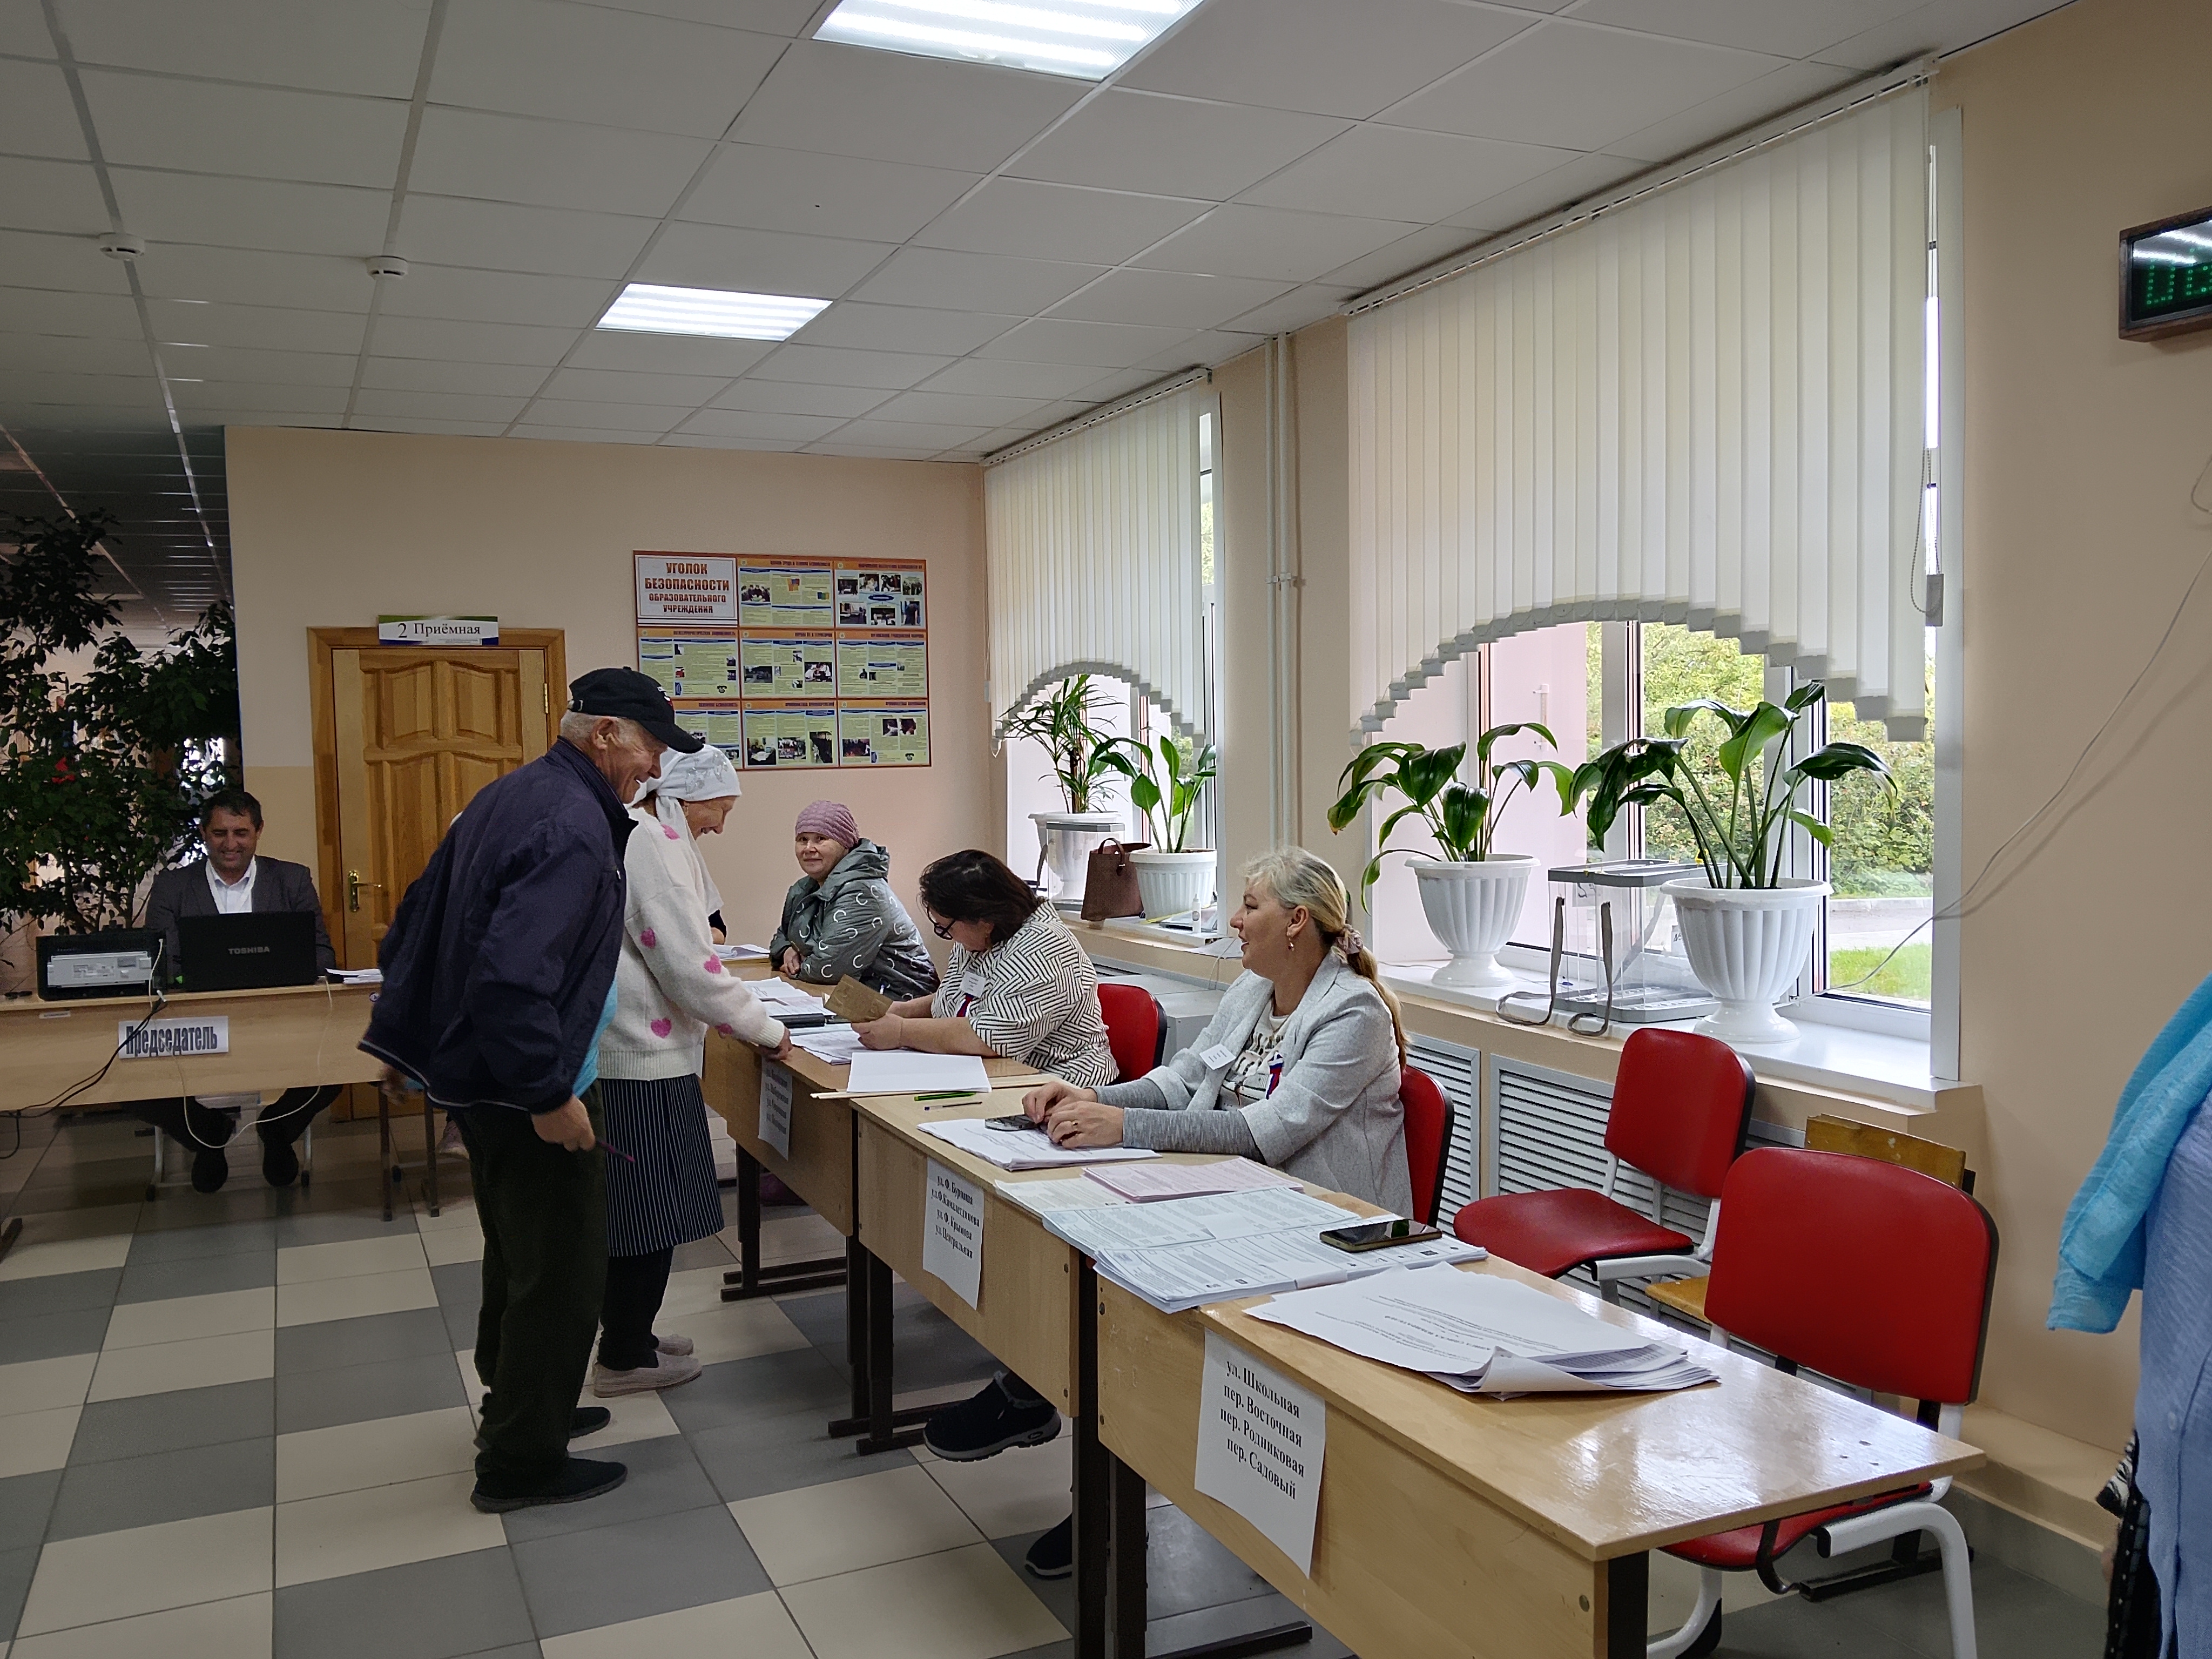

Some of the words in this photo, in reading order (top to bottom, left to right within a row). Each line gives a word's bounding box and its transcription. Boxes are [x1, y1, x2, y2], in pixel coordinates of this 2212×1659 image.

[665, 562, 707, 575] УГОЛОК
[644, 578, 730, 591] БЕЗОПАСНОСТИ
[649, 593, 726, 603] ОБРАЗОВАТЕЛЬНОГО
[663, 604, 713, 614] УЧРЕЖДЕНИЯ
[397, 623, 407, 638] 2
[414, 623, 481, 637] Приёмная
[228, 946, 270, 955] TOSHIBA
[126, 1026, 217, 1057] Председатель
[943, 1227, 973, 1259] Центральная
[1226, 1361, 1241, 1379] ул.
[1243, 1367, 1300, 1419] Школьная
[1224, 1385, 1244, 1408] пер.
[1247, 1395, 1302, 1448] Восточная
[1220, 1408, 1241, 1432] пер.
[1244, 1419, 1304, 1478] Родниковая
[1227, 1438, 1247, 1463] пер.
[1249, 1451, 1296, 1500] Садовый
